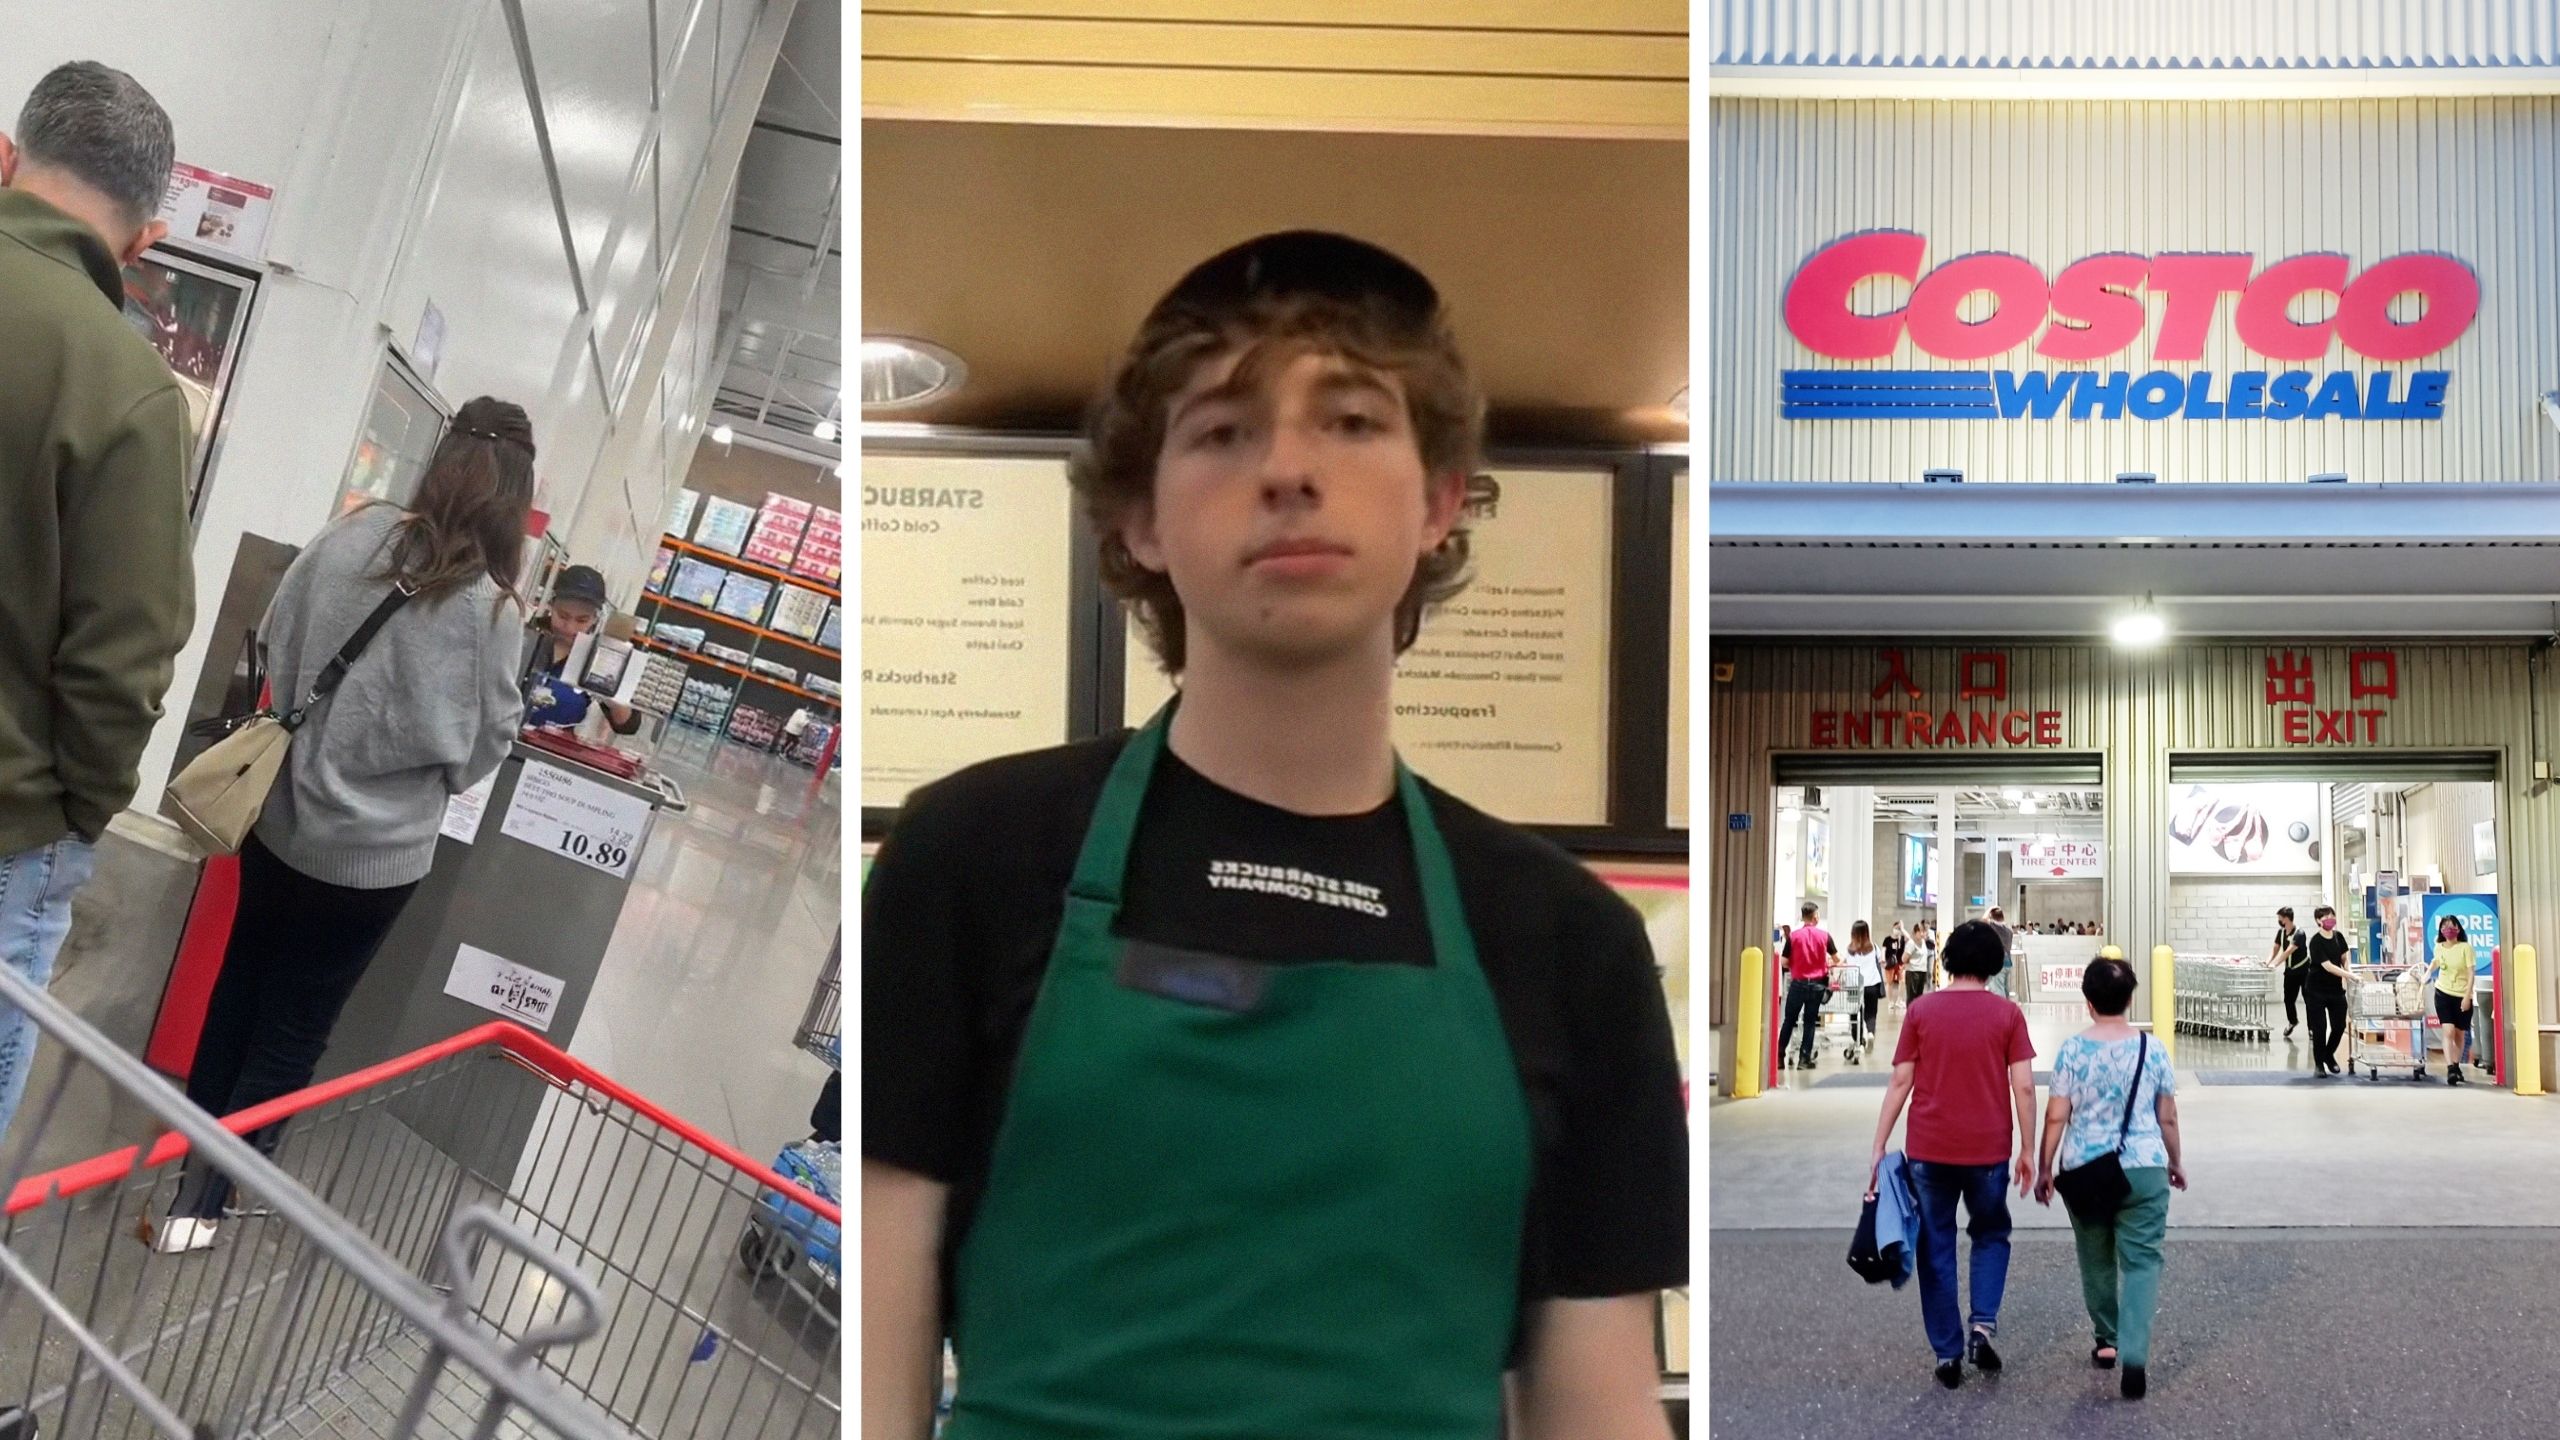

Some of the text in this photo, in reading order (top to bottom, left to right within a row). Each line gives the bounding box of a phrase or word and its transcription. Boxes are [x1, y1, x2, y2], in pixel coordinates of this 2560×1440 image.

[1784, 229, 2480, 361] COSTCO
[1994, 370, 2451, 420] WHOLESALE
[1871, 650, 2008, 701] 入口
[2266, 650, 2398, 706] 出口
[1811, 710, 2063, 746] ENTRANCE
[2284, 709, 2385, 743] EXIT
[559, 829, 628, 868] 10.89
[2020, 858, 2097, 866] TIRE CENTER
